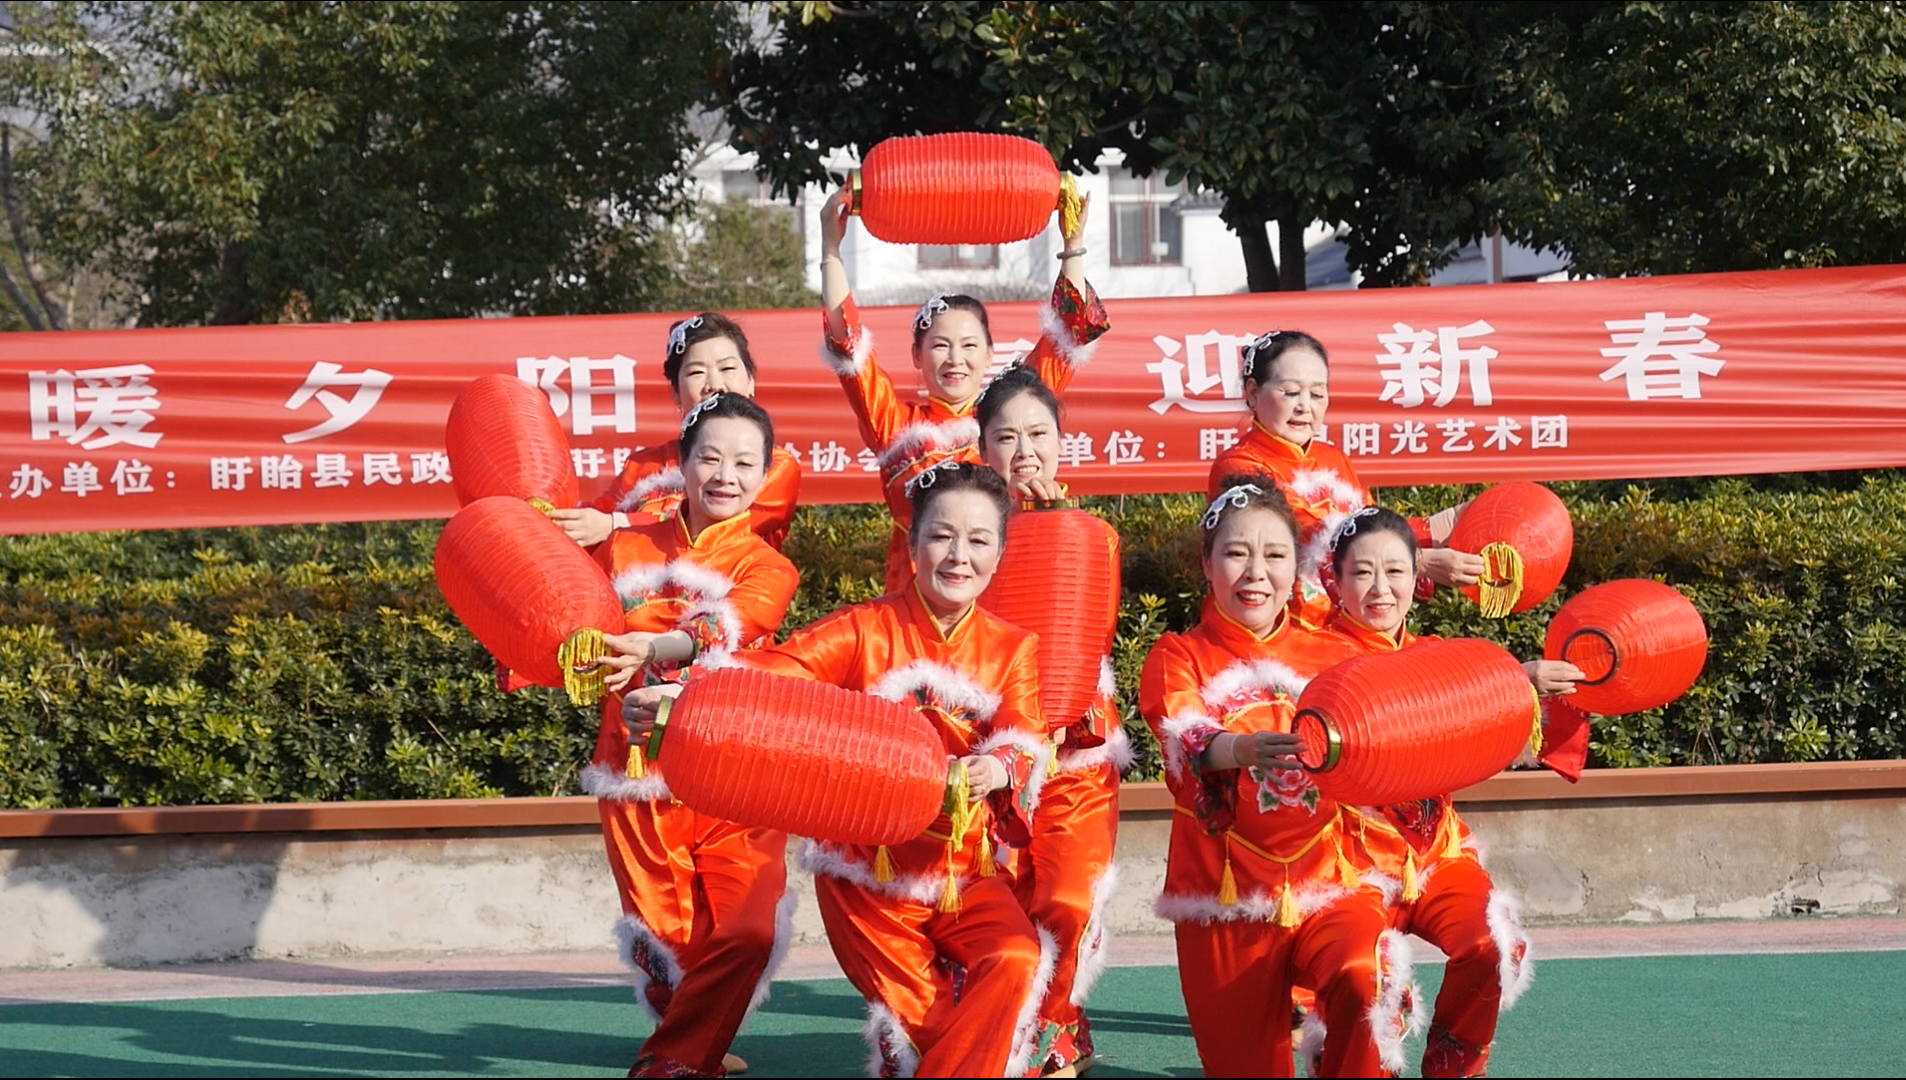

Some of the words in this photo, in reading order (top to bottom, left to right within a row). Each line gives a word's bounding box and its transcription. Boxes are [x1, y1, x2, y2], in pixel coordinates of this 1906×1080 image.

[1320, 414, 1568, 457] 阳光艺术团
